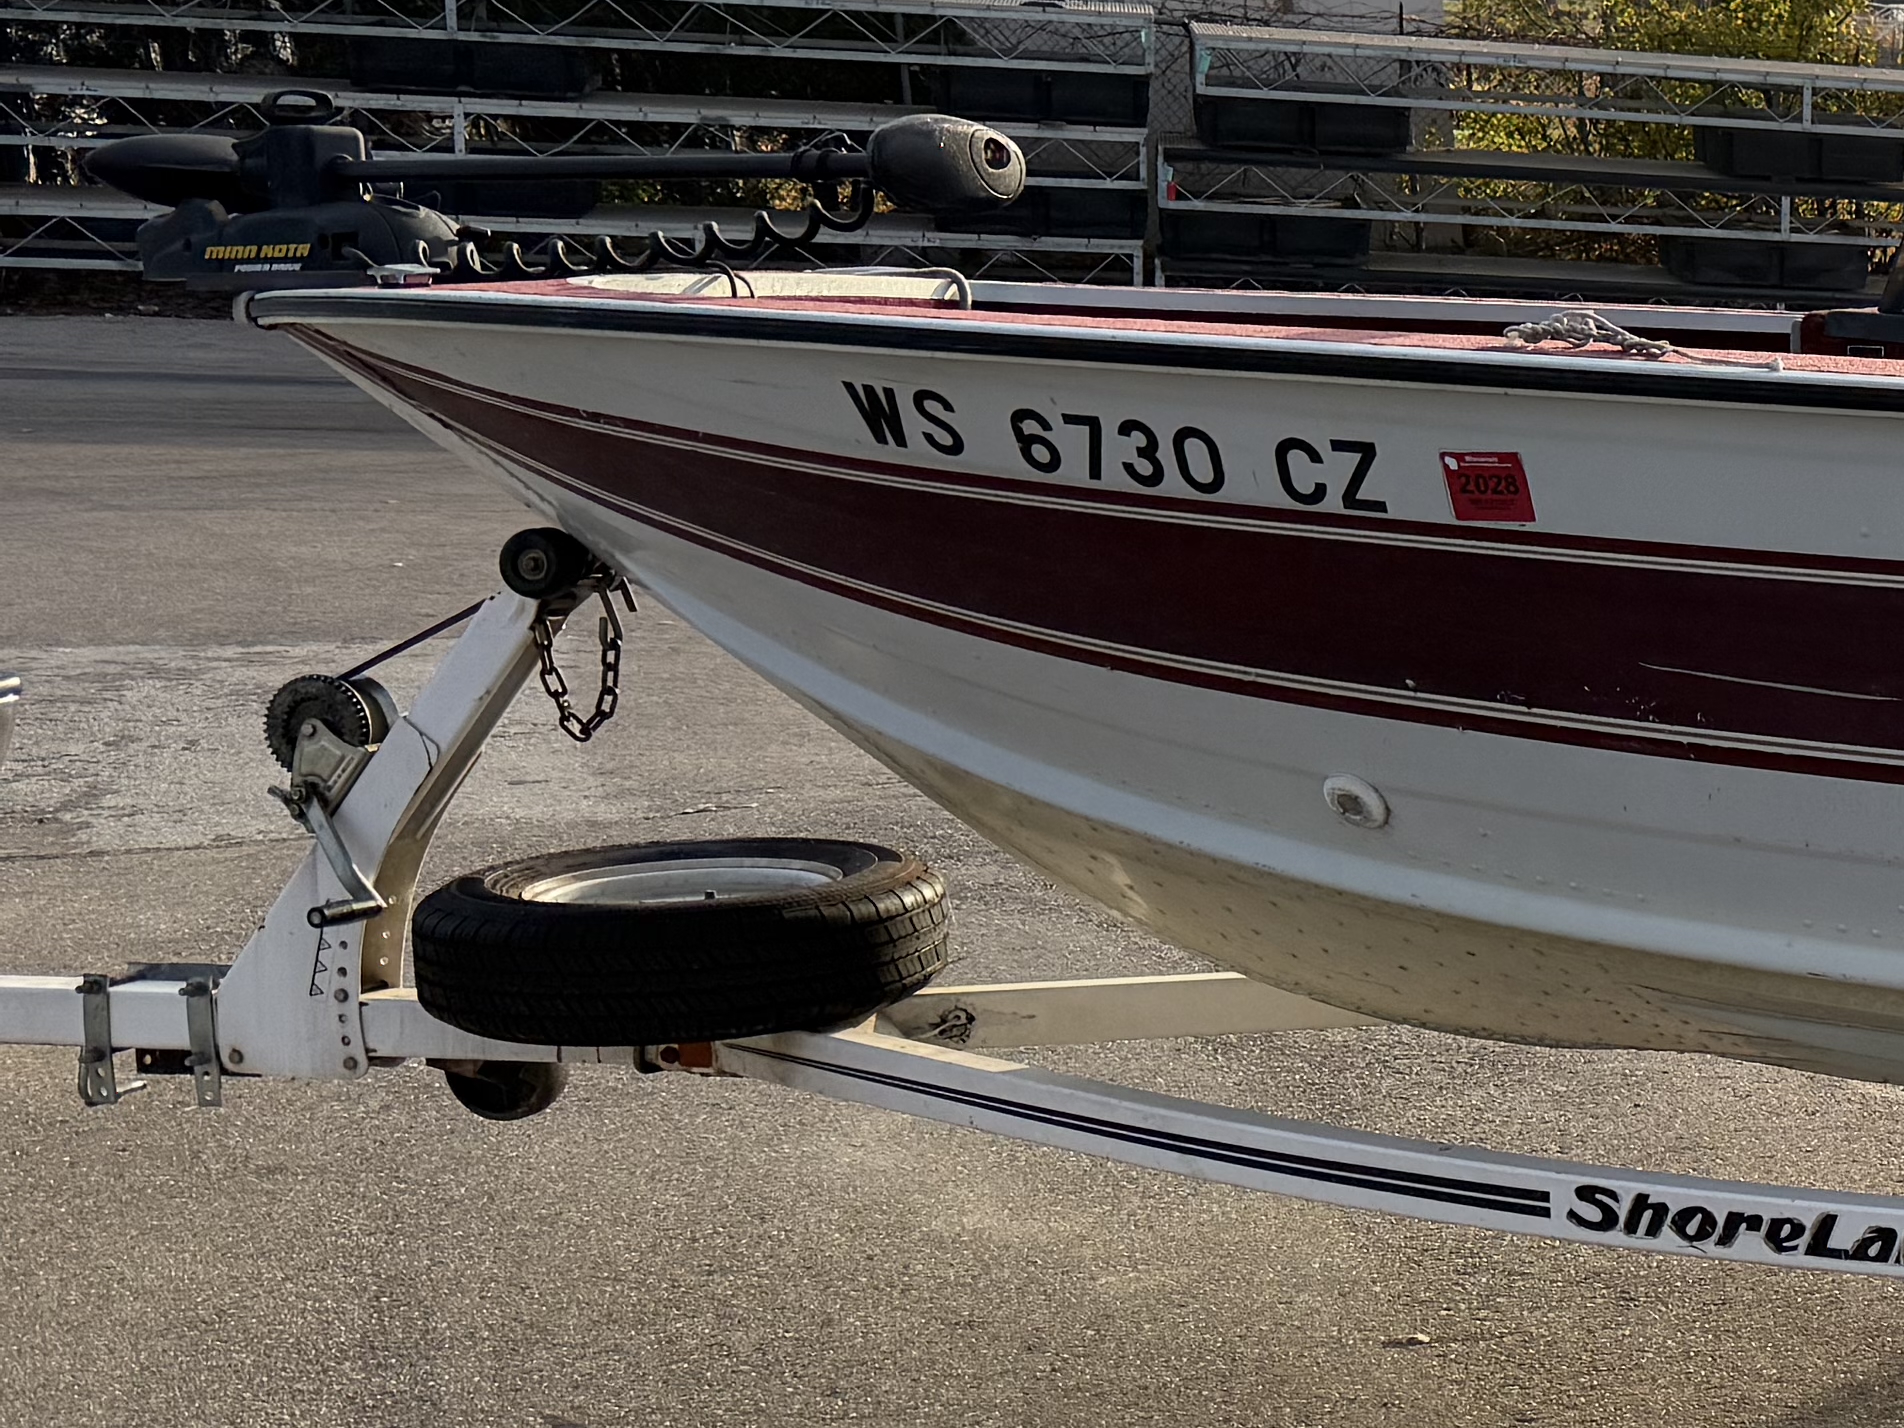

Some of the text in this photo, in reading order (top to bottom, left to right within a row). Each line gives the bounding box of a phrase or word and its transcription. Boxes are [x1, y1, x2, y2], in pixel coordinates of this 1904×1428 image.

[840, 380, 1388, 513] WS 6730 CZ
[1458, 473, 1520, 496] 2028
